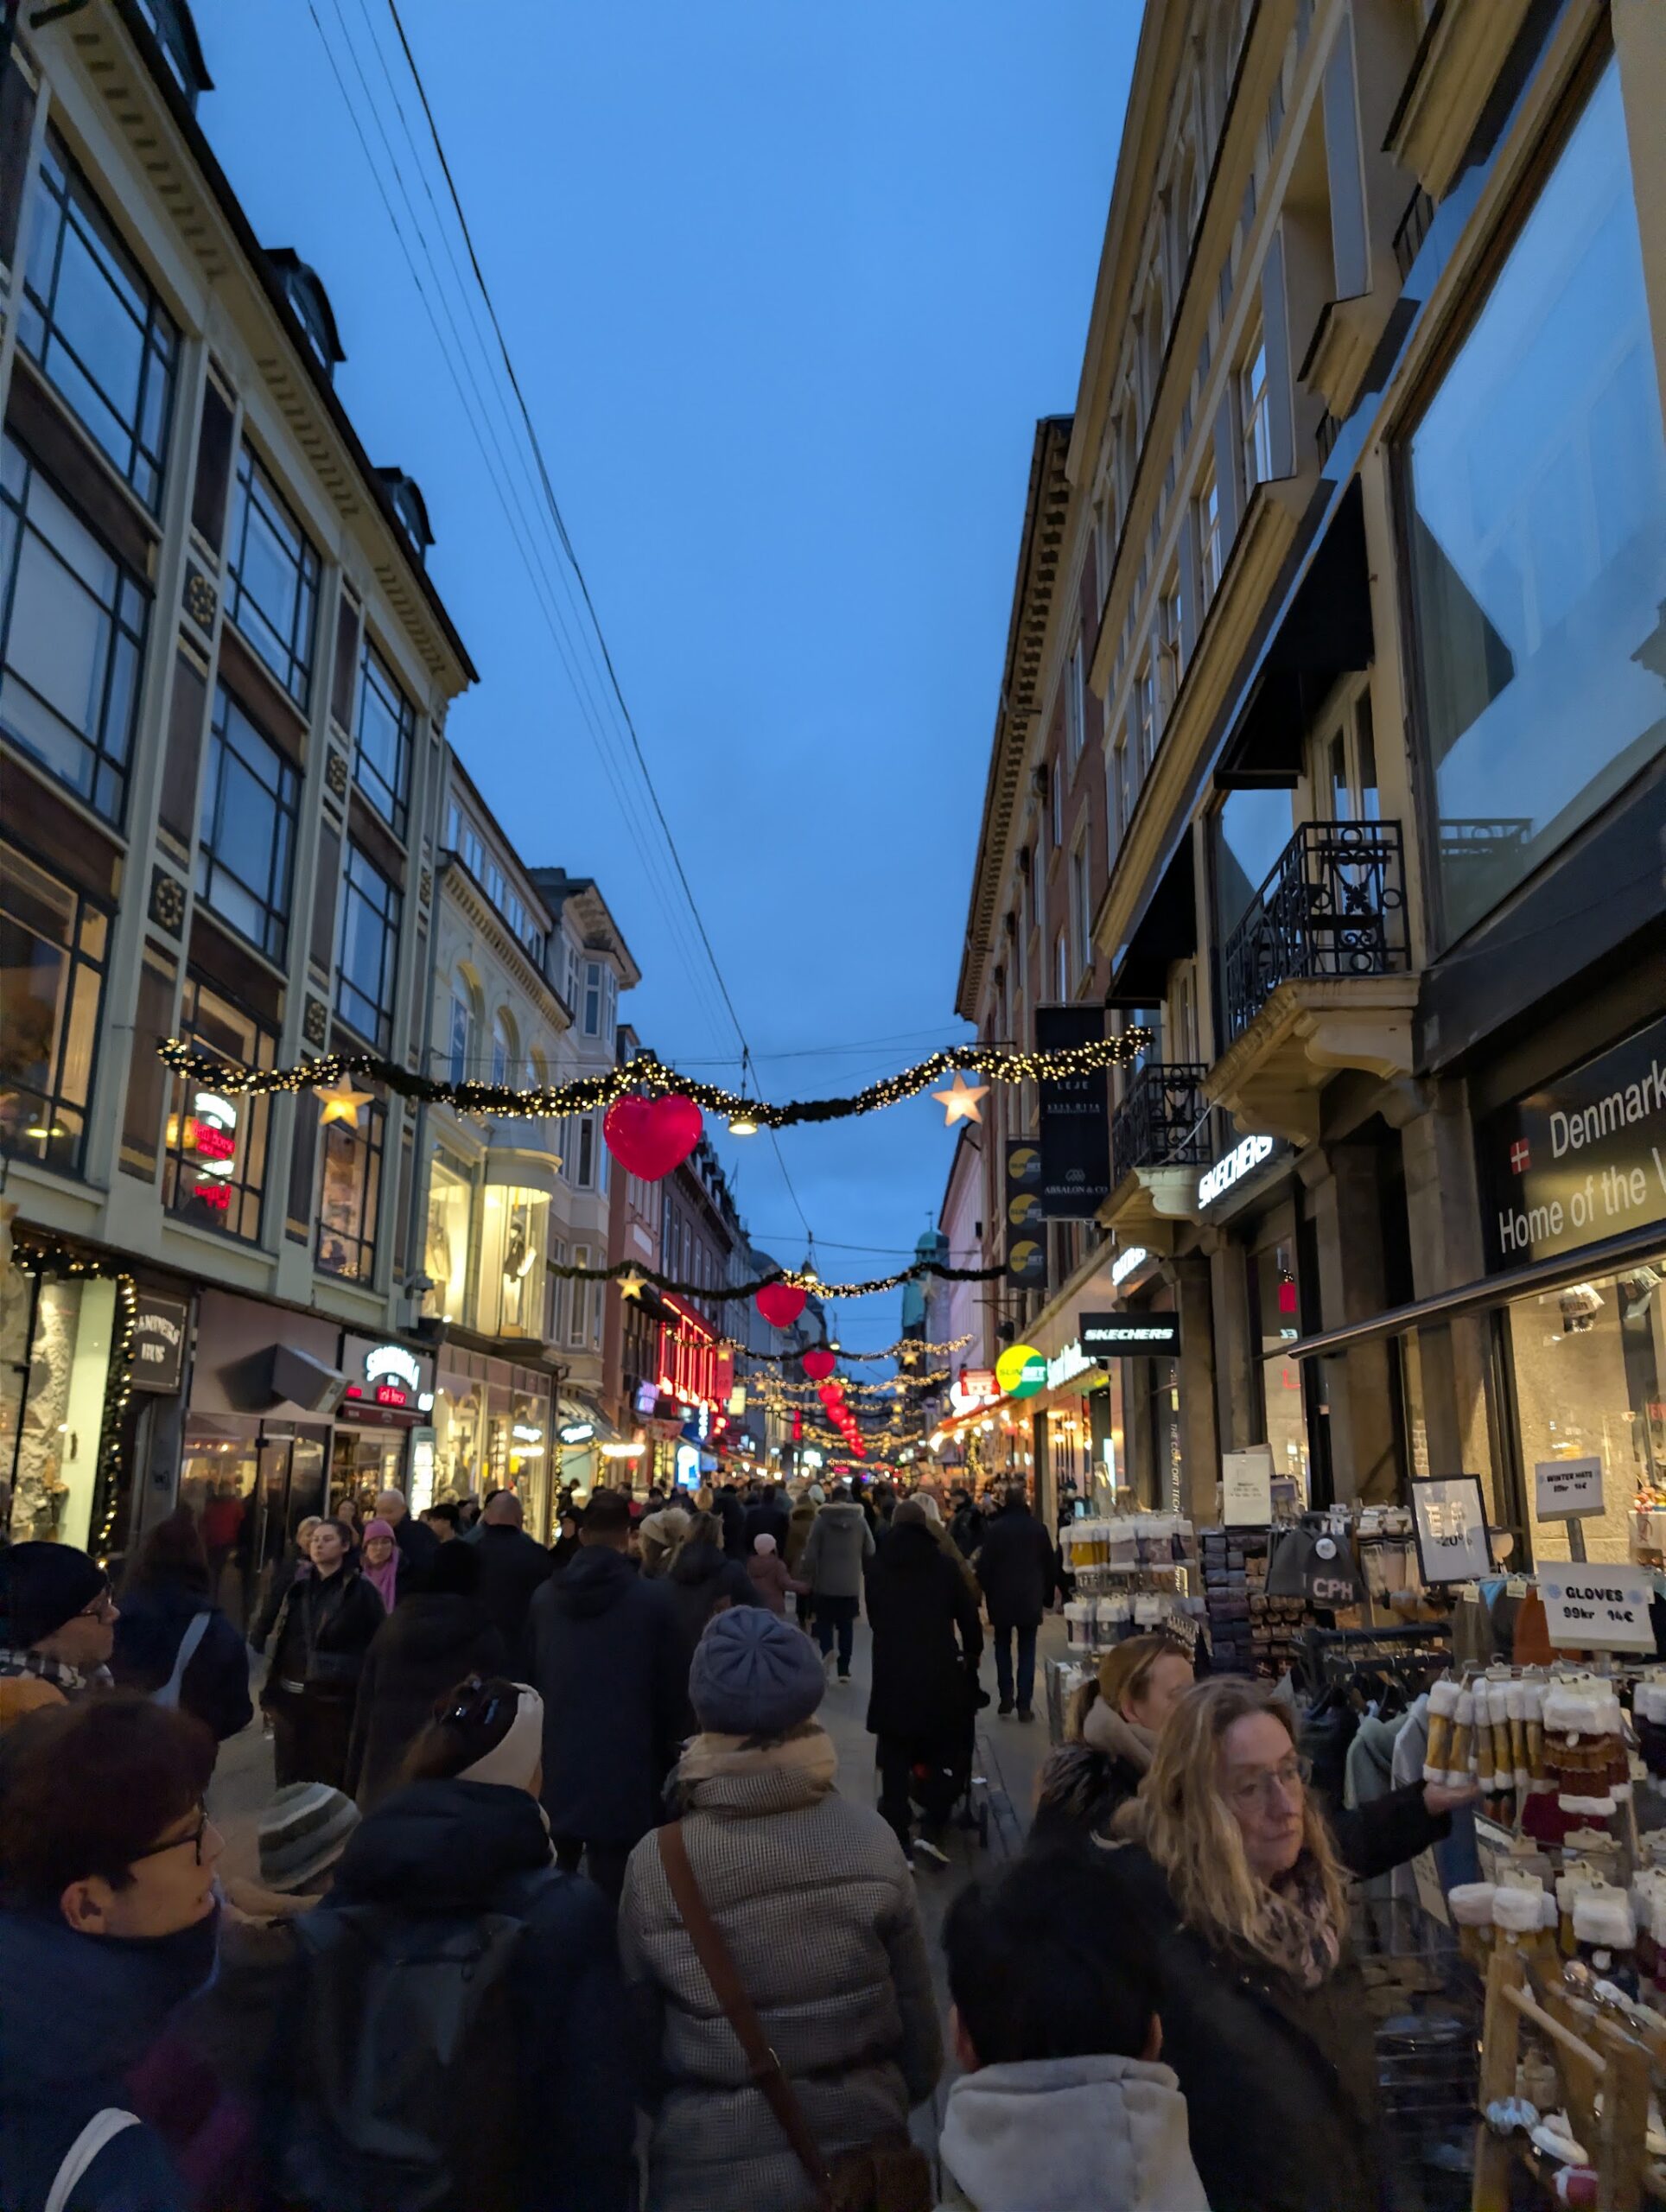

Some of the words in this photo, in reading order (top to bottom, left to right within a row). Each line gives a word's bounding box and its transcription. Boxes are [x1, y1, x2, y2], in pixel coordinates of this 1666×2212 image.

[1549, 1059, 1666, 1158] Denmark
[1044, 1185, 1085, 1195] ABSALON
[1499, 1201, 1563, 1253] Home
[1571, 1175, 1594, 1227] of
[1601, 1166, 1646, 1216] the
[1084, 1328, 1174, 1341] SKECHERS
[1313, 1578, 1353, 1600] CPH
[1565, 1586, 1625, 1603] GLOVES
[1563, 1606, 1595, 1620] 99kr
